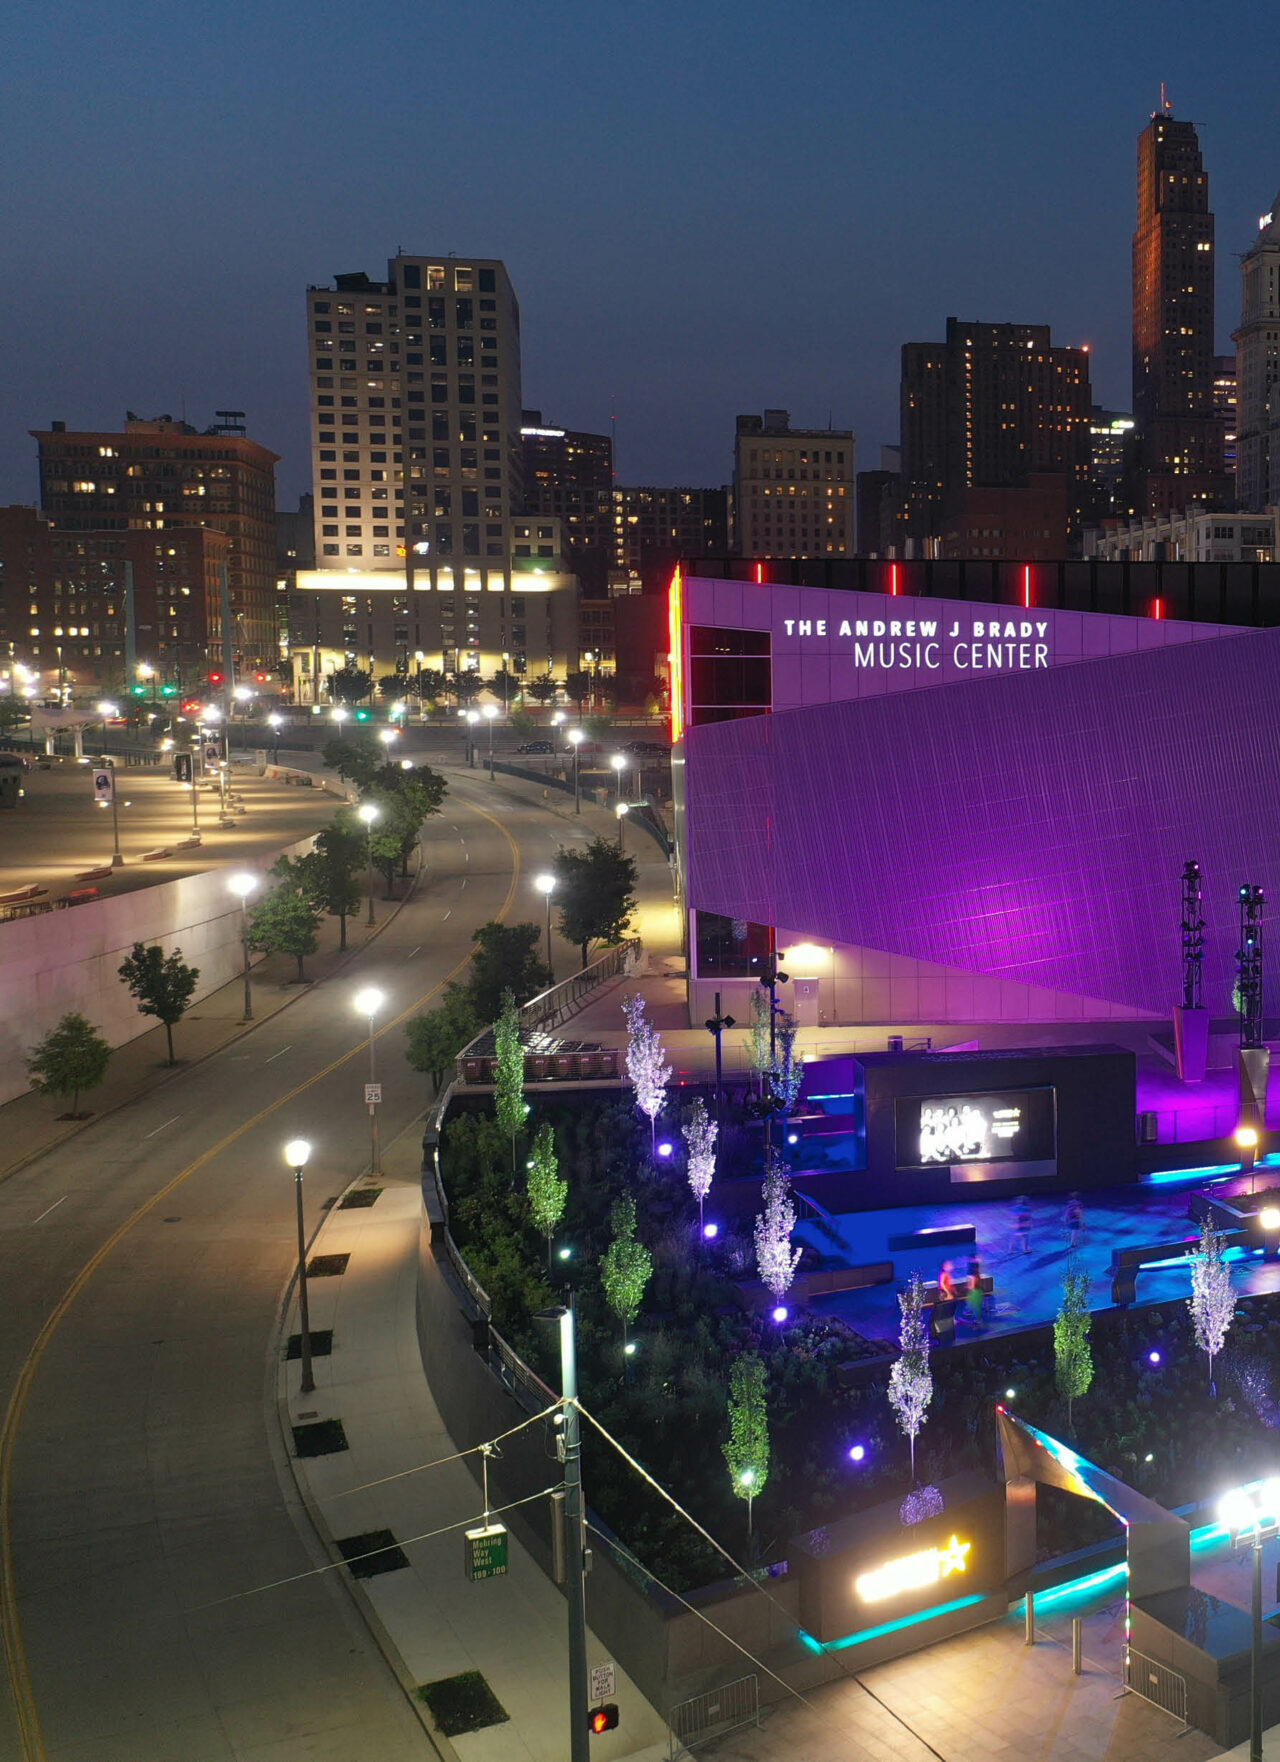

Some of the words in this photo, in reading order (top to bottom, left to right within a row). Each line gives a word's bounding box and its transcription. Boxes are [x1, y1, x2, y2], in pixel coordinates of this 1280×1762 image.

[784, 619, 827, 636] THE
[839, 619, 937, 637] ANDREW
[949, 621, 960, 637] J
[973, 621, 1048, 637] BRADY
[854, 642, 940, 668] MUSIC
[953, 643, 1048, 668] CENTER
[367, 1093, 380, 1101] 25
[473, 1537, 502, 1550] Mehring
[473, 1550, 489, 1559] Way
[473, 1556, 492, 1567] West
